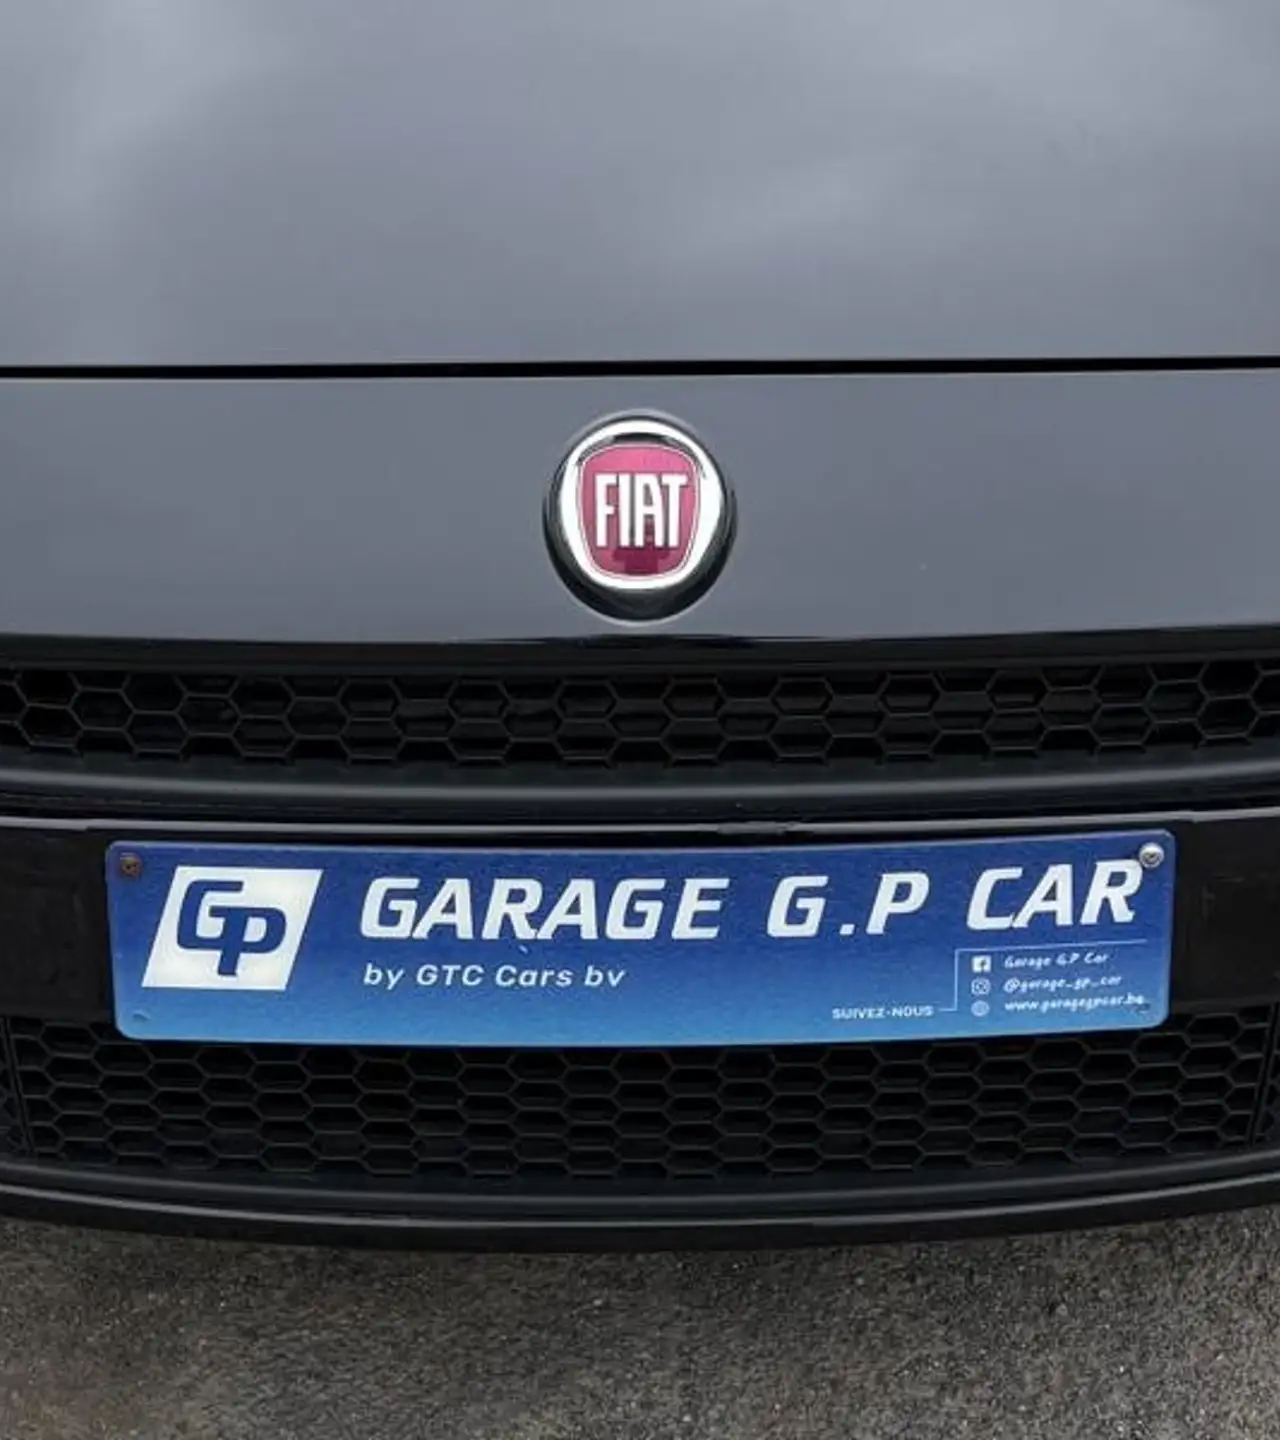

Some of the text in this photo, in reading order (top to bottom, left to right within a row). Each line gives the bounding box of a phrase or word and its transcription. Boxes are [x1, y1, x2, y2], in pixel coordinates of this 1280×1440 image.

[595, 472, 689, 548] FIAT
[360, 876, 730, 941] GARAGE
[766, 871, 931, 939] G.P
[965, 858, 1144, 931] CAR
[1004, 954, 1052, 970] Garage
[1083, 951, 1110, 964] Car
[363, 962, 626, 990] by GTC Cars bv
[831, 1004, 936, 1019] SUIVEZ-NOUS
